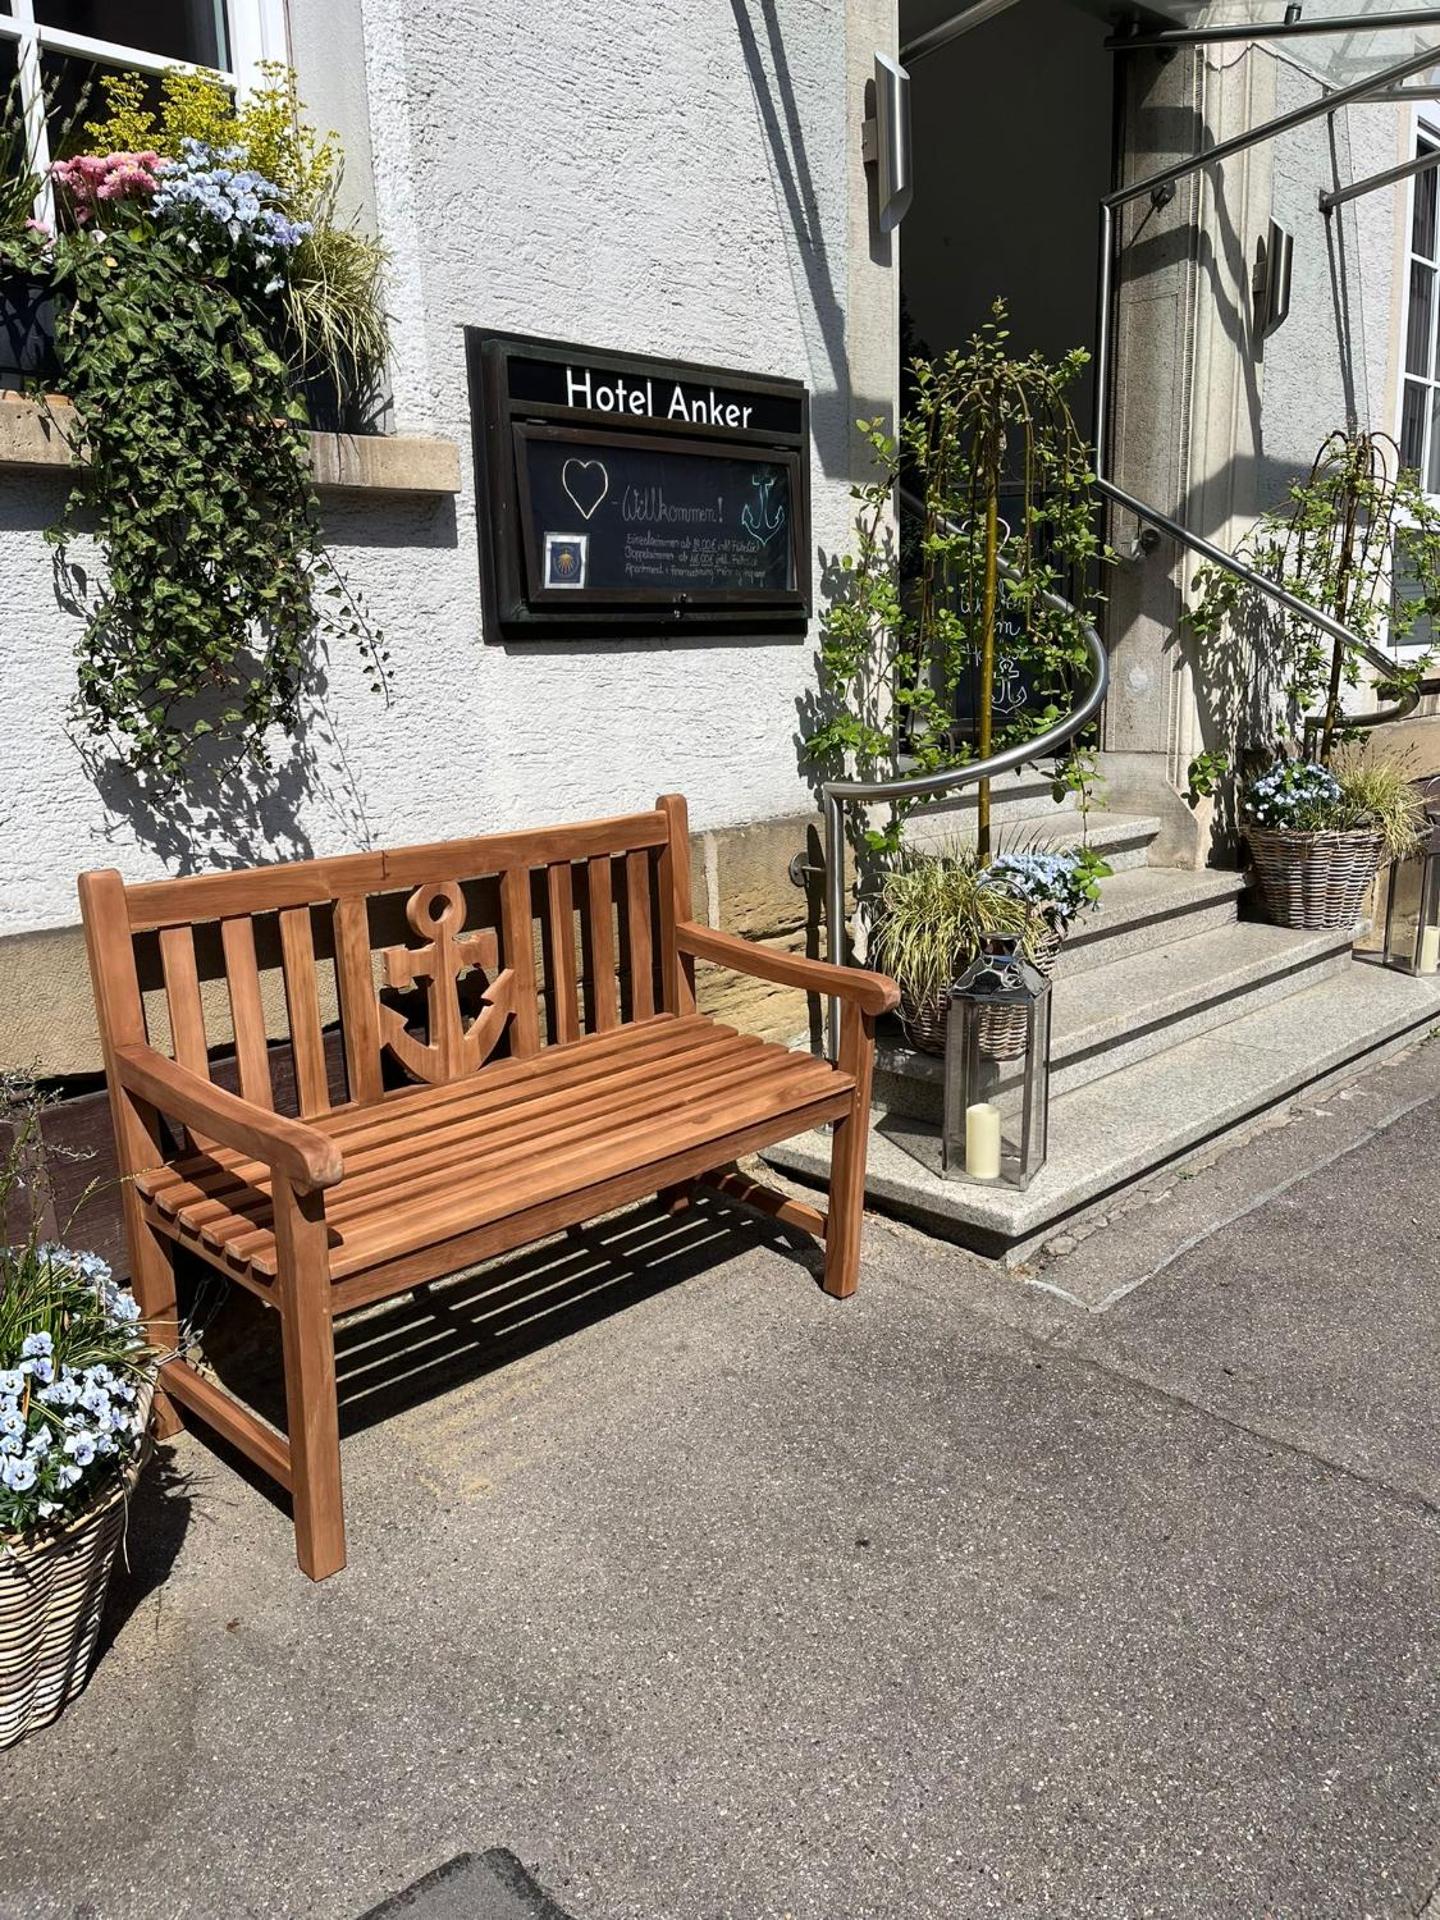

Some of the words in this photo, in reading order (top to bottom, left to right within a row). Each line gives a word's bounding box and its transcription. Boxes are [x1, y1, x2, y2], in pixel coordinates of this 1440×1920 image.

[566, 367, 653, 418] Hotel
[667, 383, 753, 429] Anker
[622, 485, 724, 524] Willkommen!
